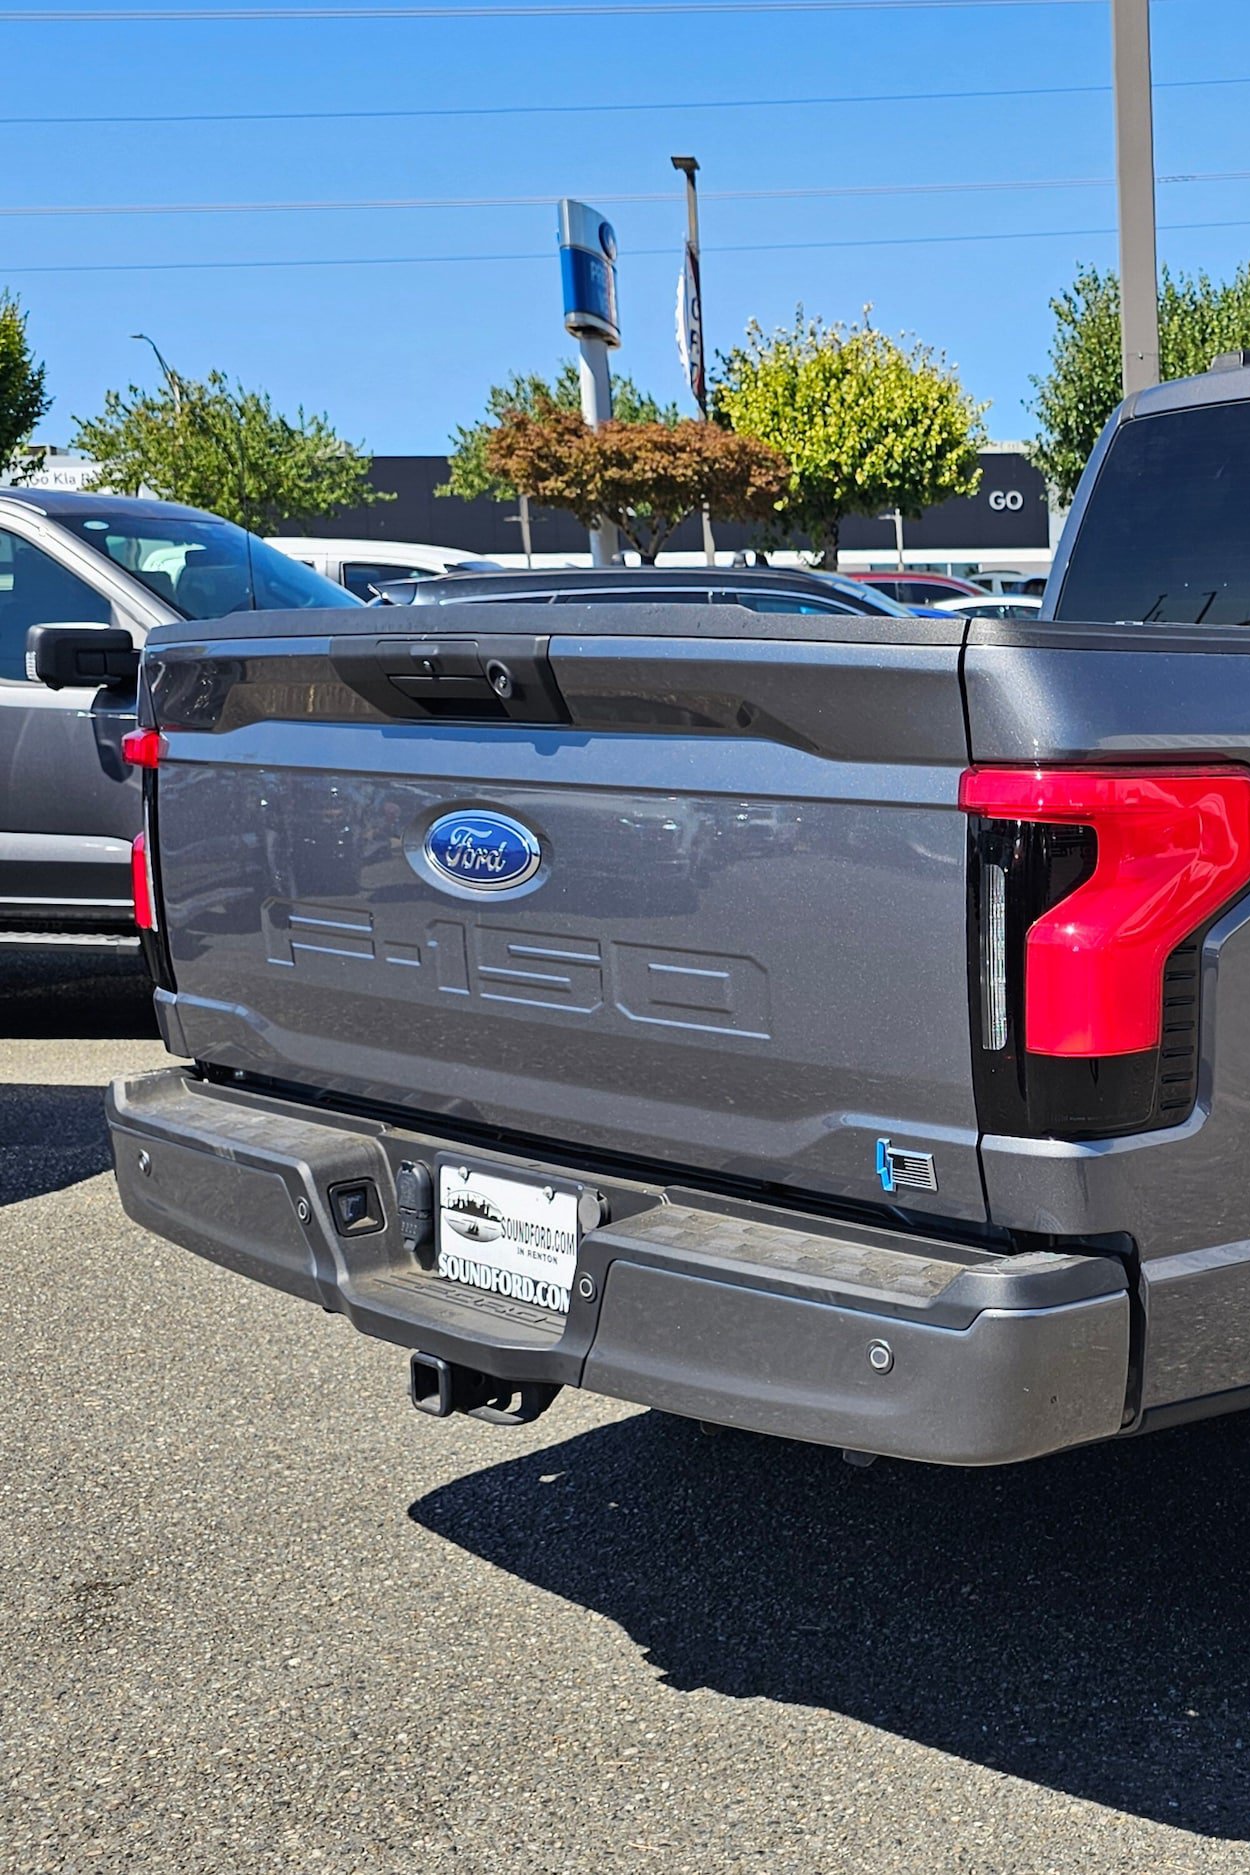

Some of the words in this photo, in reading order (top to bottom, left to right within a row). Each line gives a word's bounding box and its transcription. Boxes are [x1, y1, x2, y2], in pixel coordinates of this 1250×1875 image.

[988, 490, 1024, 511] GO
[445, 825, 510, 873] Ford
[261, 896, 772, 1041] F-150
[500, 1215, 576, 1257] SOUNDFORD.COM
[516, 1246, 526, 1256] IN
[527, 1249, 559, 1265] RENTON
